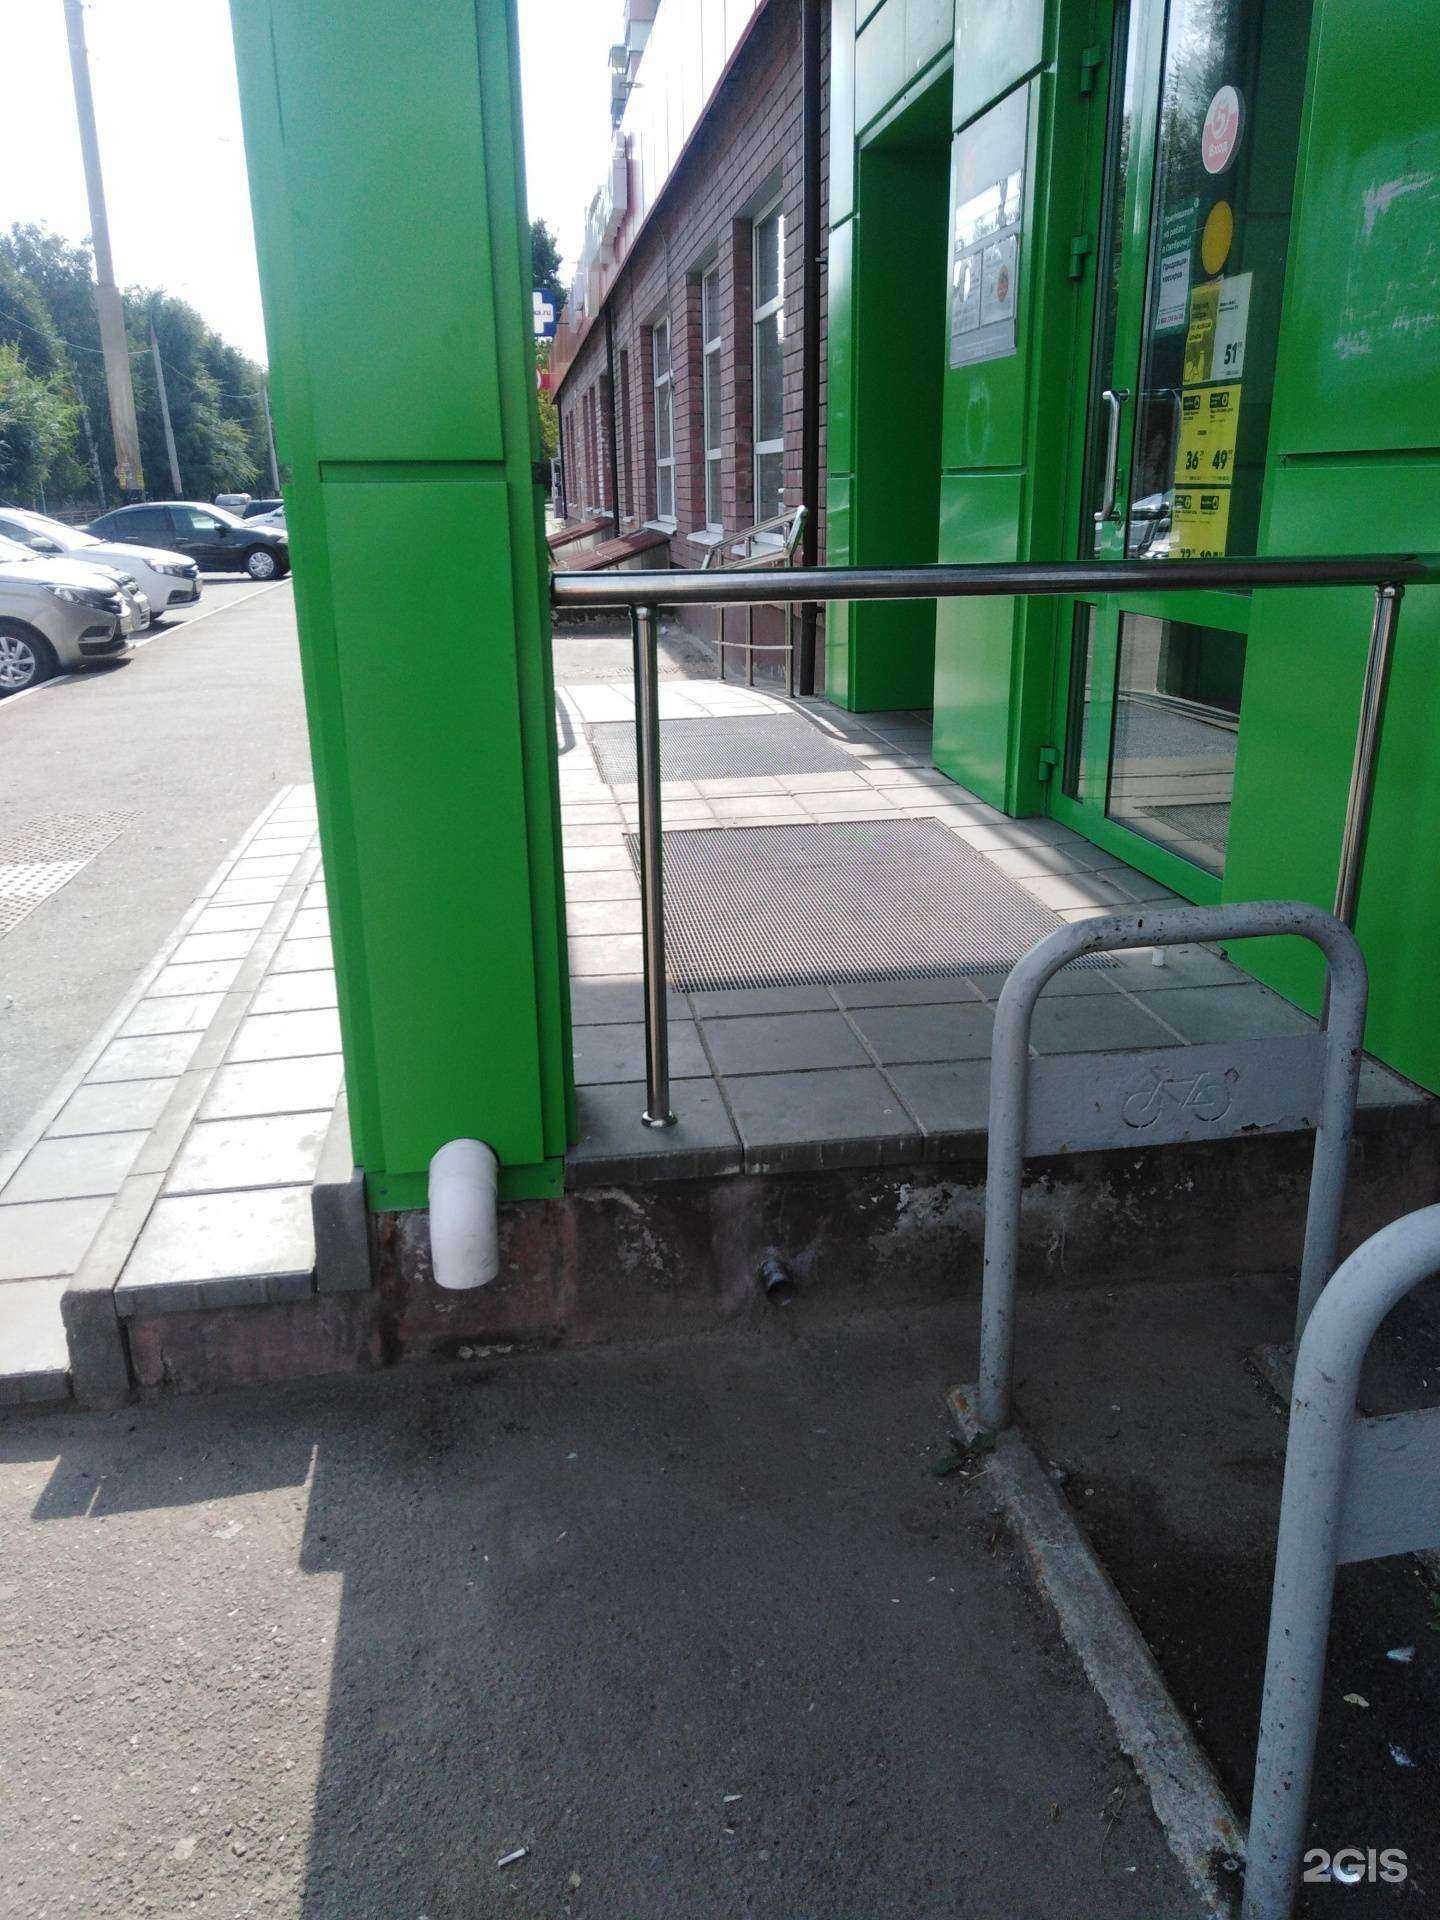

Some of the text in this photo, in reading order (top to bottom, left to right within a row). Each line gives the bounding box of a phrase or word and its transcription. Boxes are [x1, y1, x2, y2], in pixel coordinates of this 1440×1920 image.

[1224, 342, 1238, 365] 51
[1186, 449, 1228, 470] 36 49
